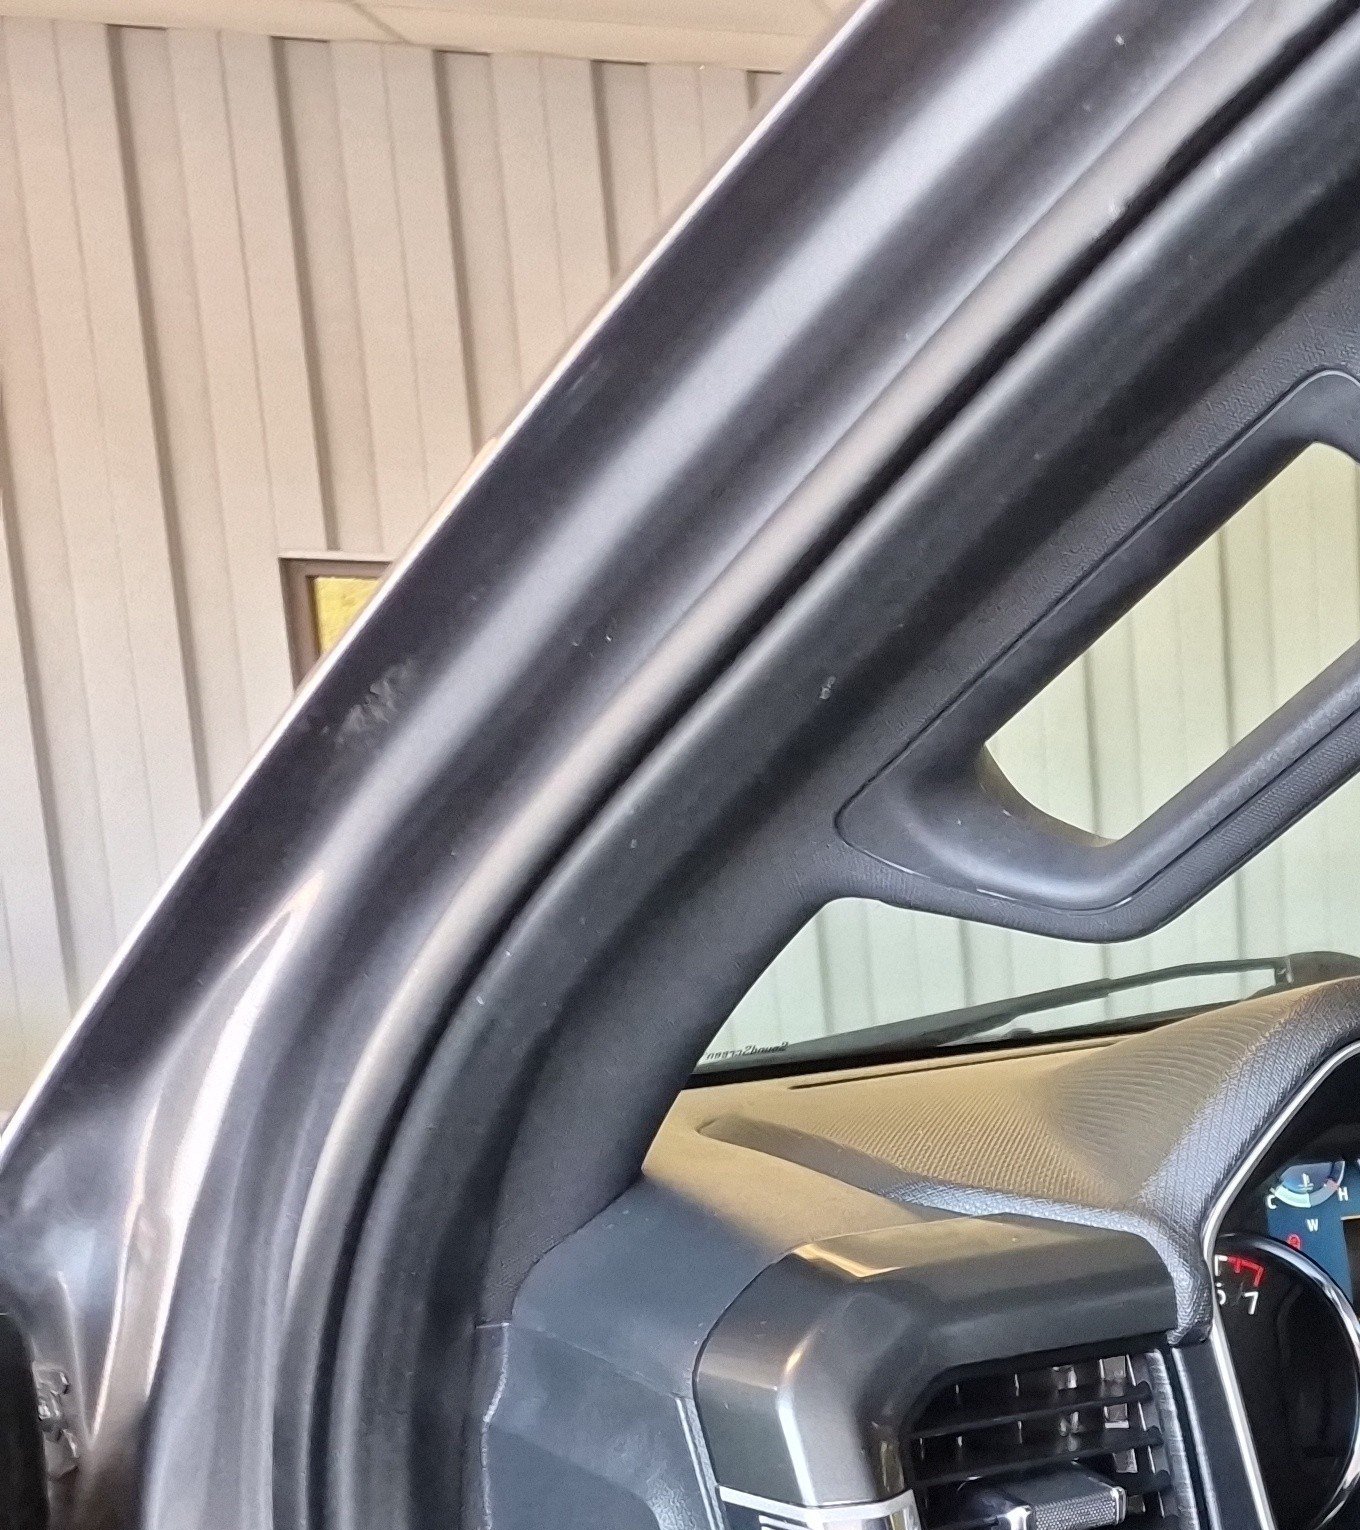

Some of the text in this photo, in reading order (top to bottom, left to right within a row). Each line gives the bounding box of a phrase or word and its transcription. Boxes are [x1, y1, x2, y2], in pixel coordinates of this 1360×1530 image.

[1338, 1187, 1348, 1201] H
[1266, 1195, 1277, 1210] C
[1305, 1218, 1319, 1232] W
[1242, 1291, 1259, 1315] 7
